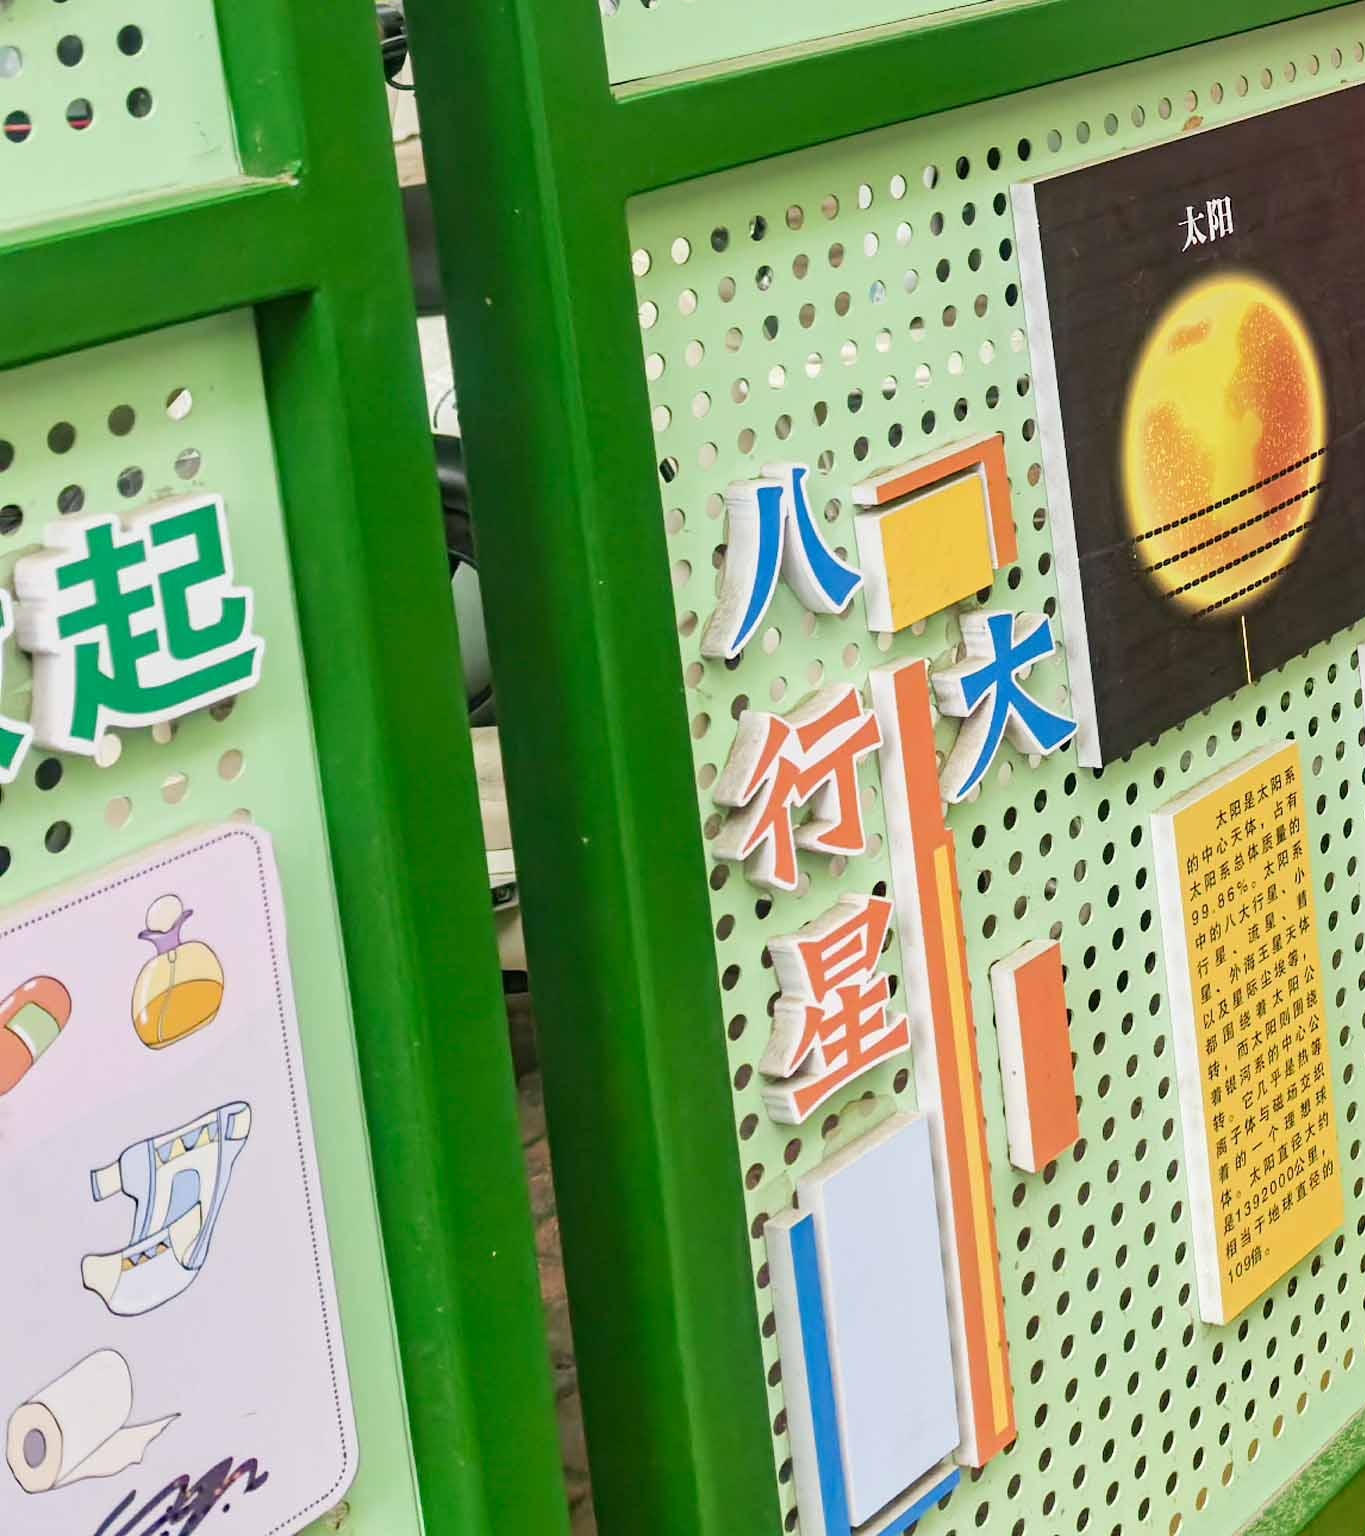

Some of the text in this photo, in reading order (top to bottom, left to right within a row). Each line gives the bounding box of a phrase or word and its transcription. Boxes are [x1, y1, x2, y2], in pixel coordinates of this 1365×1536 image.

[1177, 195, 1235, 252] 太阳
[1187, 792, 1296, 874] 的中心天体，占有
[1217, 766, 1295, 829] 太阳是太阳系
[1190, 817, 1299, 900] 太阳系总体质量的
[1195, 868, 1304, 949] 中的八大行星、小
[1201, 916, 1309, 1004] 星、外海王星天体
[1203, 949, 1306, 1029] 以及星际尘埃等，
[1206, 966, 1314, 1054] 都围绕着太阳公
[1208, 990, 1317, 1079] 转，而太阳则围绕
[1211, 1015, 1319, 1105] 着银河系的中心公
[1213, 1038, 1321, 1131] 转。它几乎是热等
[1219, 1086, 1327, 1182] 着的一个理想球
[1221, 1112, 1328, 1209] 体。太阳直径大约
[1226, 1161, 1333, 1259] 相当于地球直径的
[1229, 1246, 1269, 1283] 109倍。
